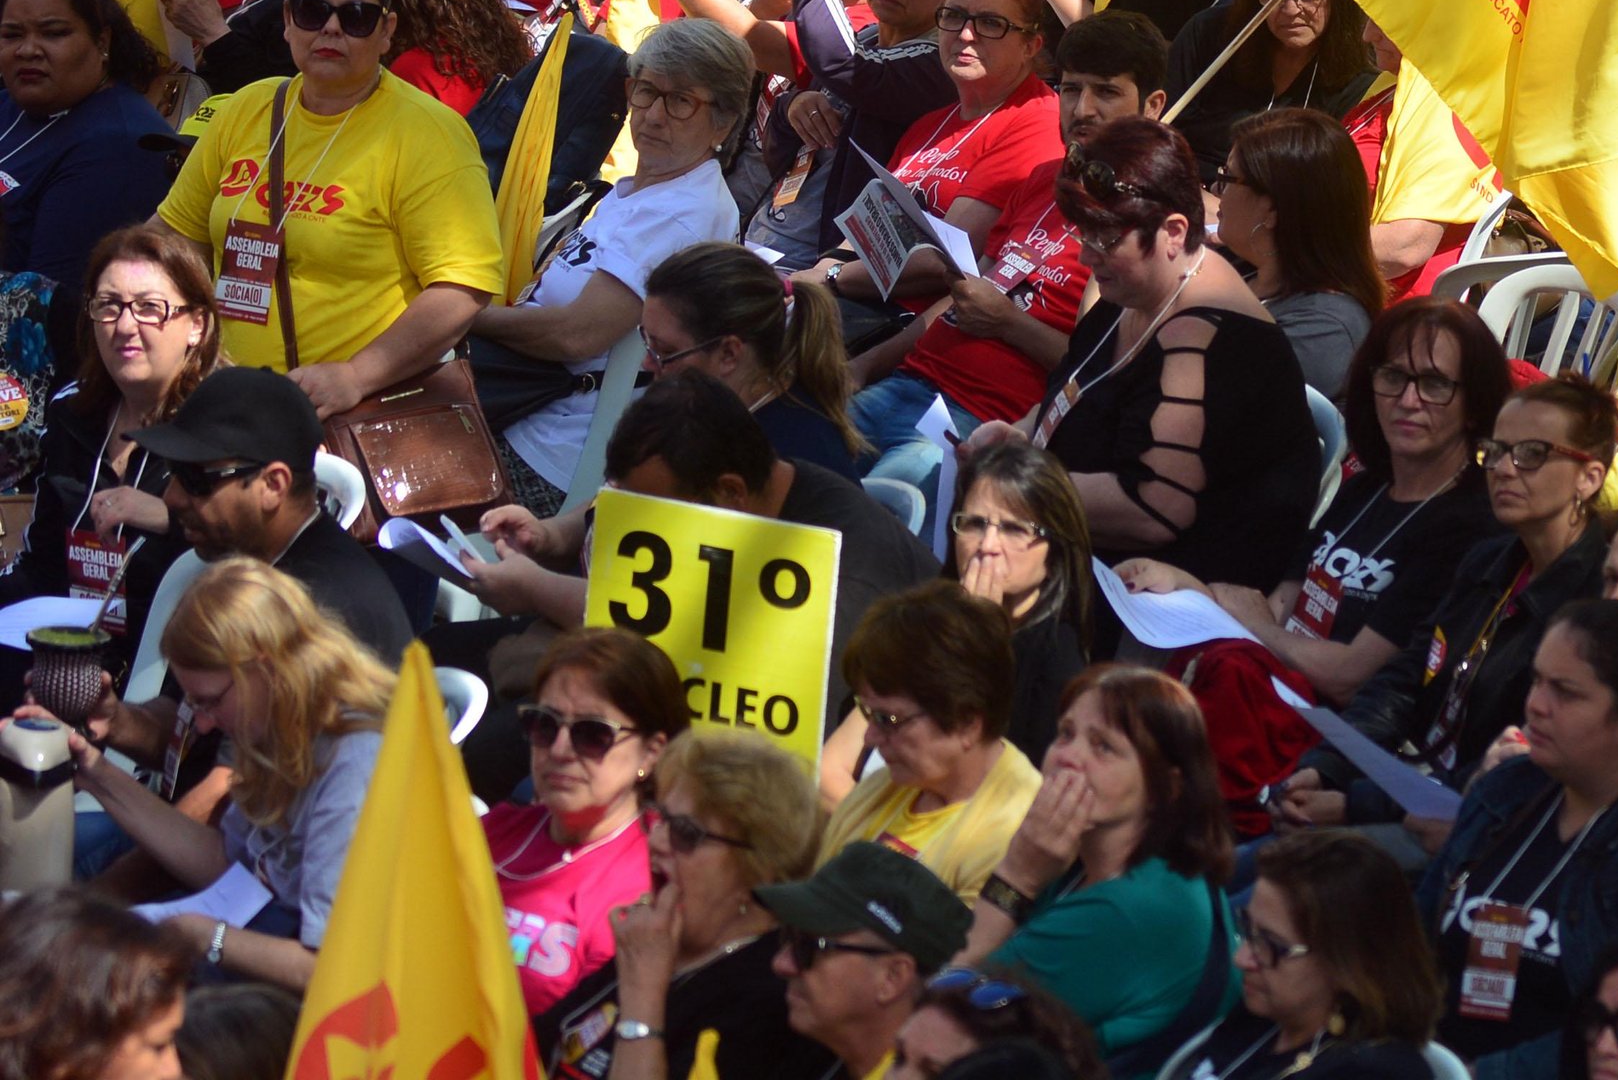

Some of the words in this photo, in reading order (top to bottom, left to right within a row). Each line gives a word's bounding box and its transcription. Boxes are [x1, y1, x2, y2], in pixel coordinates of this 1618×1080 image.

[255, 182, 345, 216] CERS
[226, 235, 279, 259] ASSEMBLEIA
[236, 252, 263, 271] GERAL
[223, 283, 263, 305] SÓCIA(O)
[68, 545, 123, 567] ASSEMBLEIA
[83, 561, 110, 581] GERAL
[607, 530, 812, 653] 31º
[685, 677, 800, 737] CLEO
